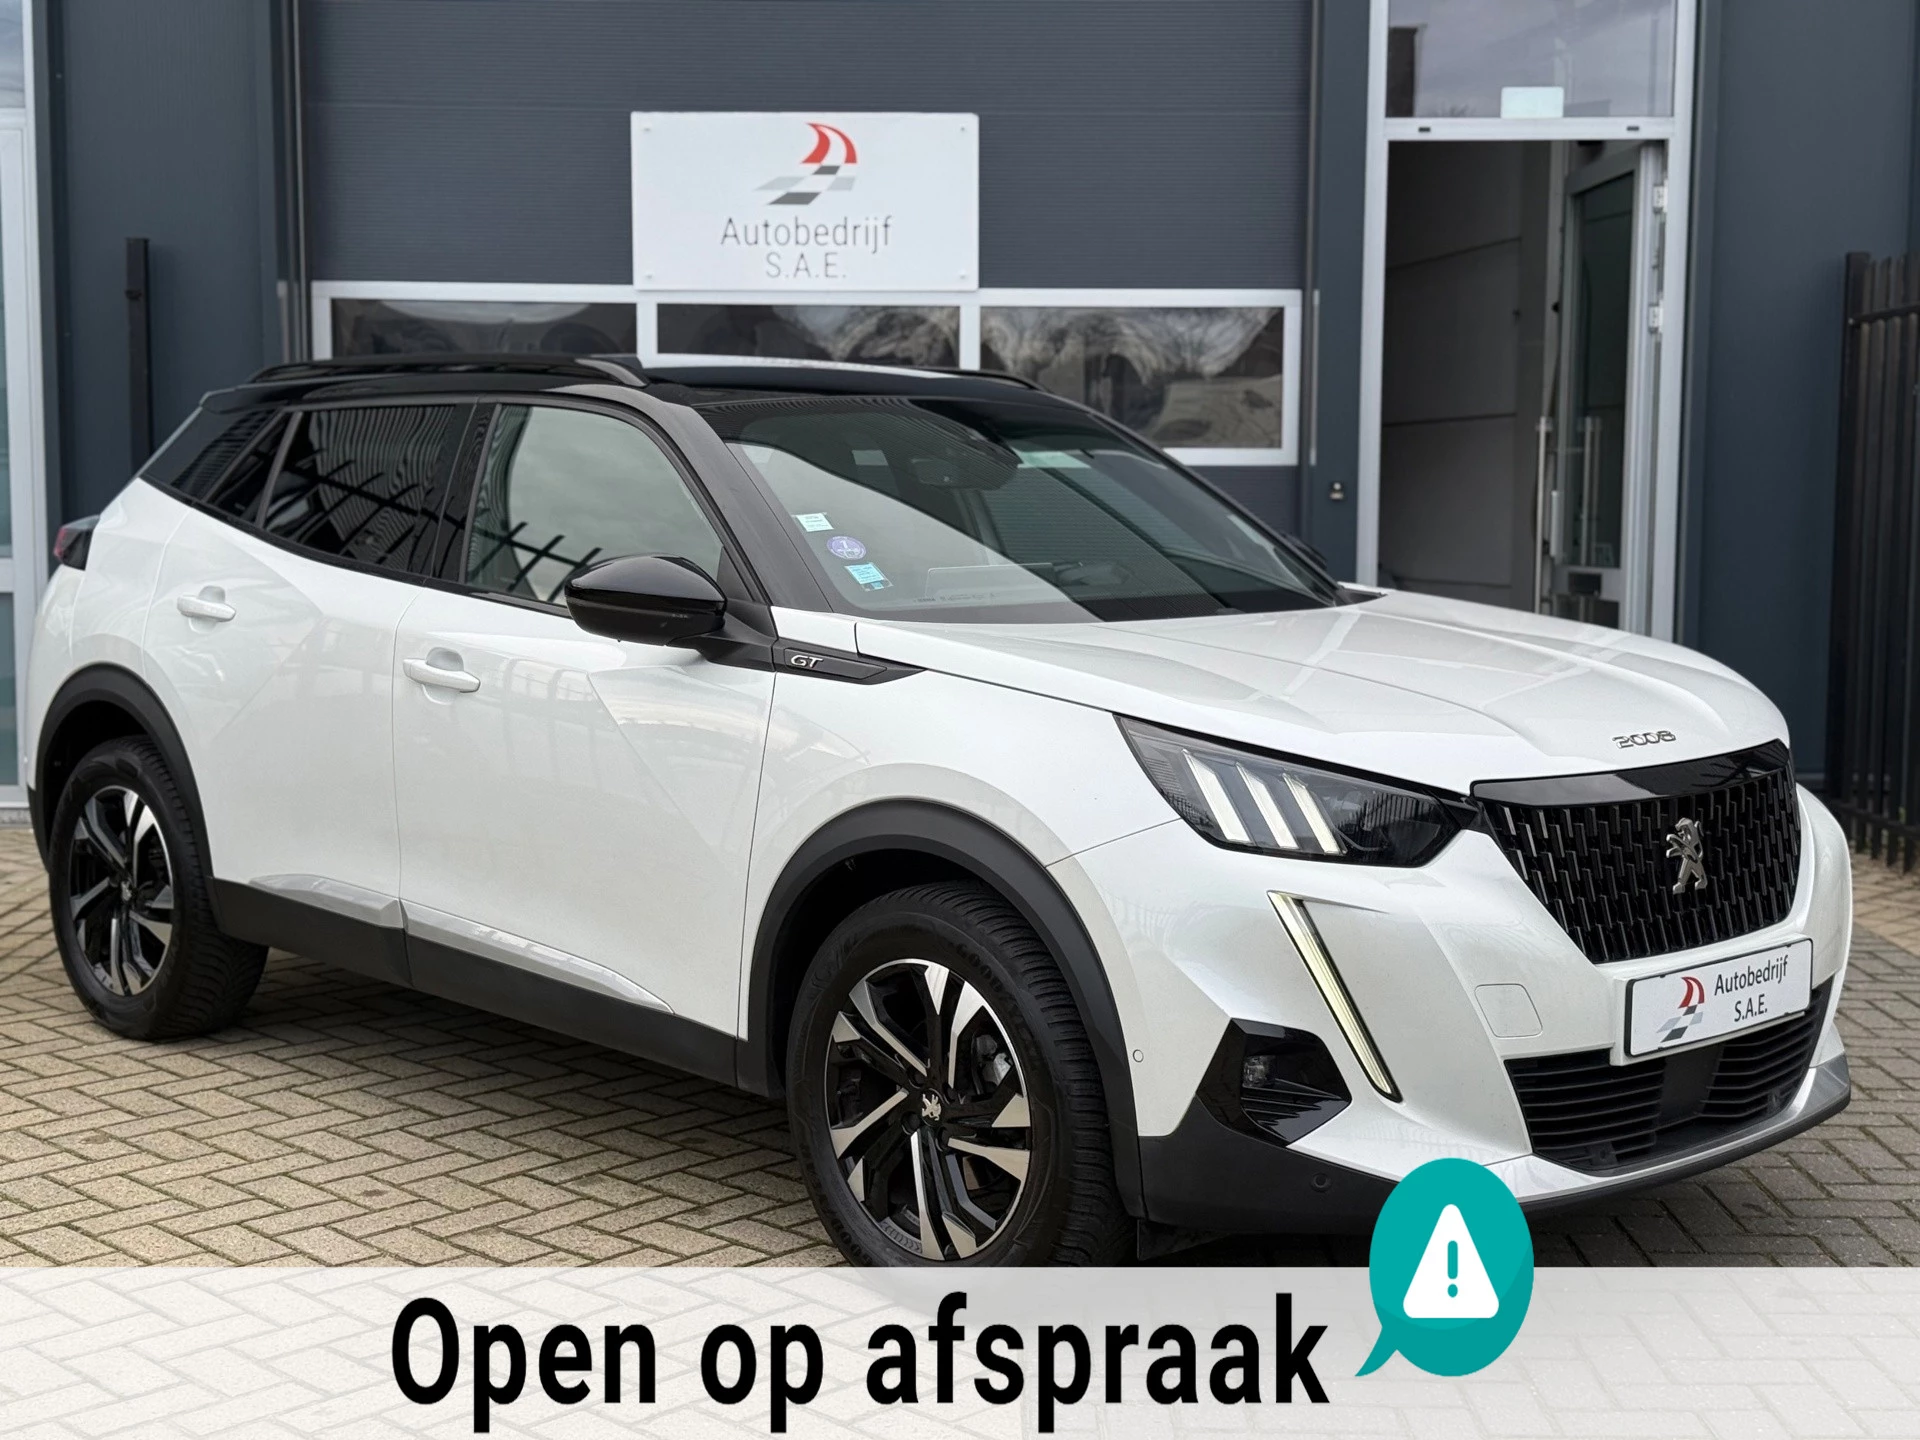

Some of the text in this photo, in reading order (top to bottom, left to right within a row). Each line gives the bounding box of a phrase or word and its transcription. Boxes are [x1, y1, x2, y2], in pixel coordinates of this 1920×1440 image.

[720, 216, 892, 254] Autobedrijf
[765, 252, 847, 279] S.A.E.
[790, 654, 824, 668] GT
[1612, 730, 1676, 749] 2008
[1714, 954, 1789, 996] Autobedrijf
[1734, 993, 1768, 1023] S.A.E.
